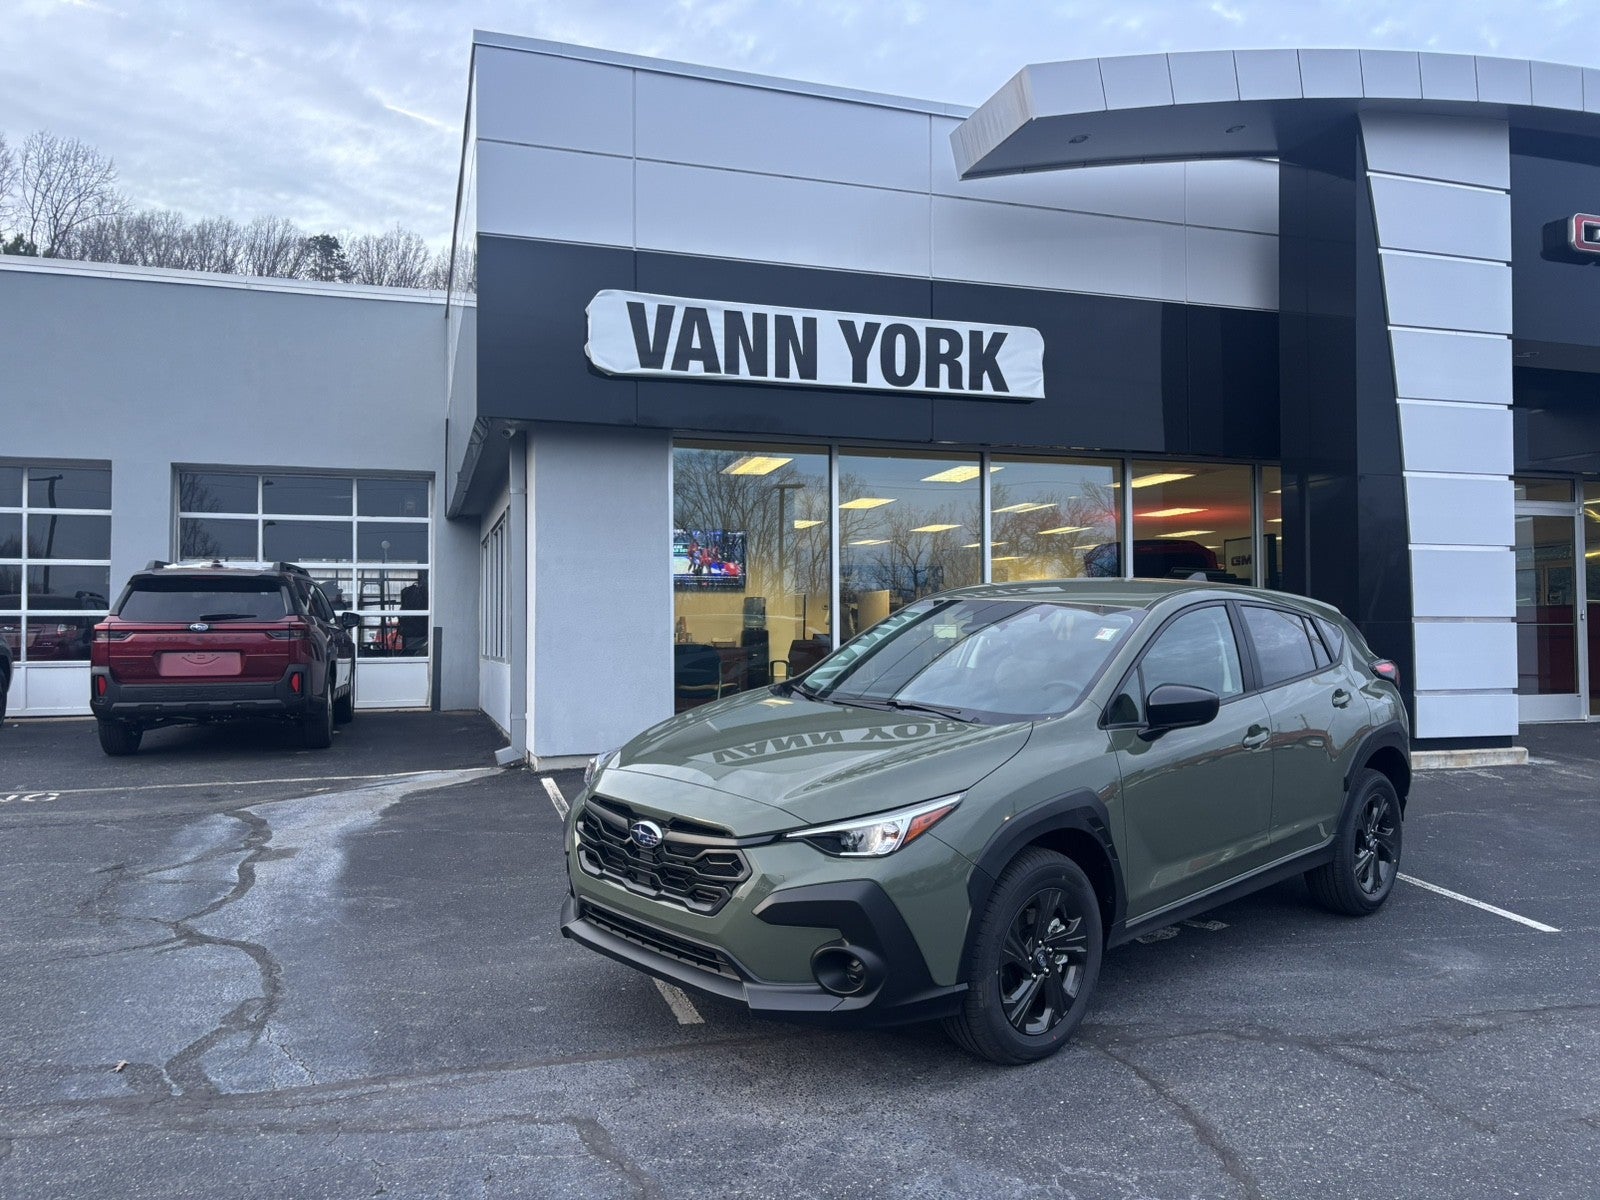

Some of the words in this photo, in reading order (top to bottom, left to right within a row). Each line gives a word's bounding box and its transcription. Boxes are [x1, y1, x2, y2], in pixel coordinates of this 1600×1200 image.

[626, 301, 818, 381] VANN
[837, 319, 1010, 393] YORK
[1231, 553, 1252, 567] GM
